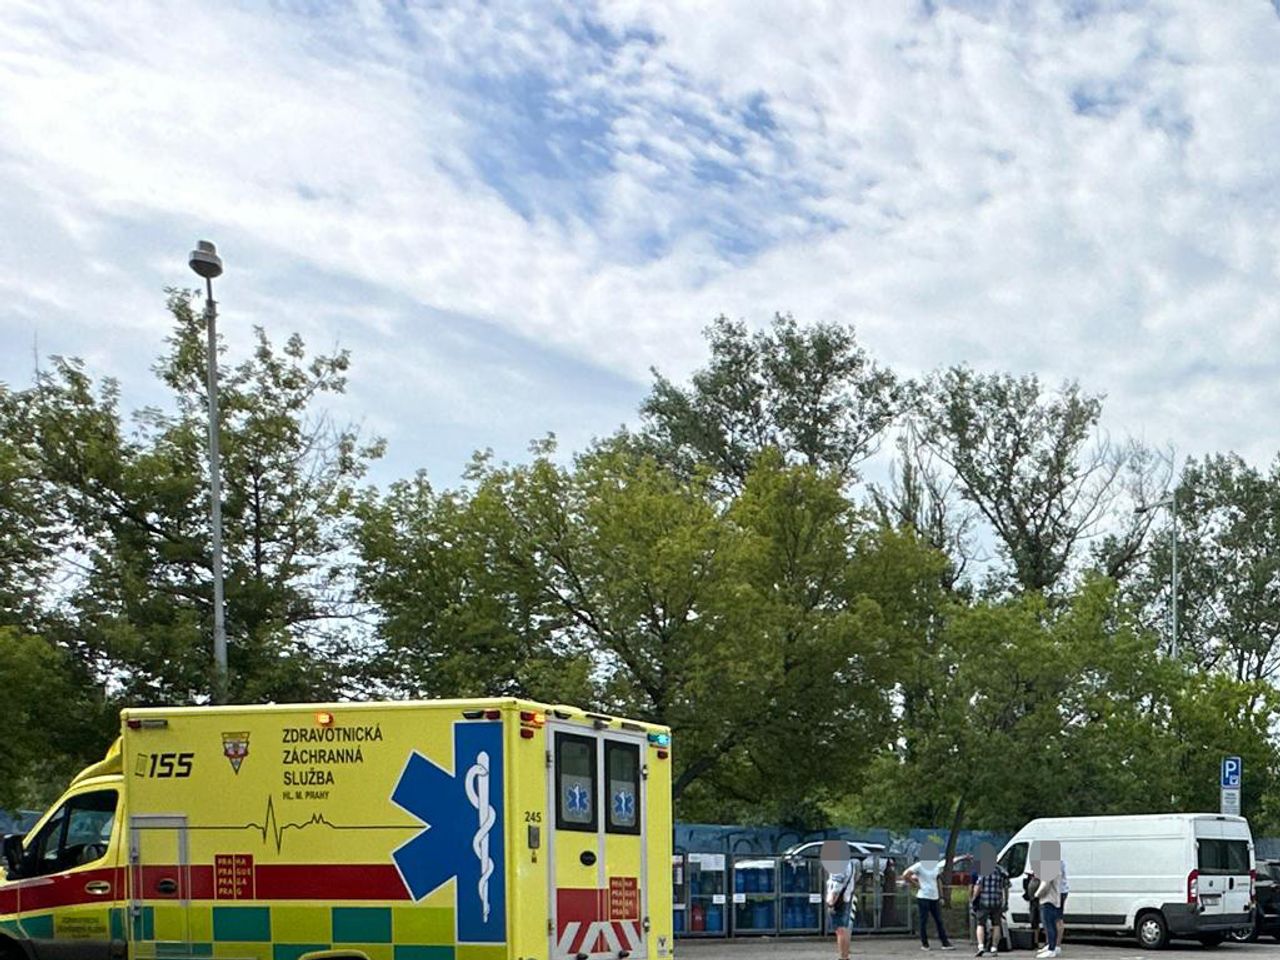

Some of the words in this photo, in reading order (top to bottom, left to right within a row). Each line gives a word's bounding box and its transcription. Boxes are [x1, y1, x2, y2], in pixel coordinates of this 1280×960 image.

[282, 722, 383, 743] ZDRAVOTNICKÁ
[282, 744, 364, 764] ZÁCHRANNÁ
[149, 752, 195, 778] 155
[1225, 760, 1238, 778] P
[283, 767, 335, 786] SLUŽBA
[524, 811, 542, 823] 245
